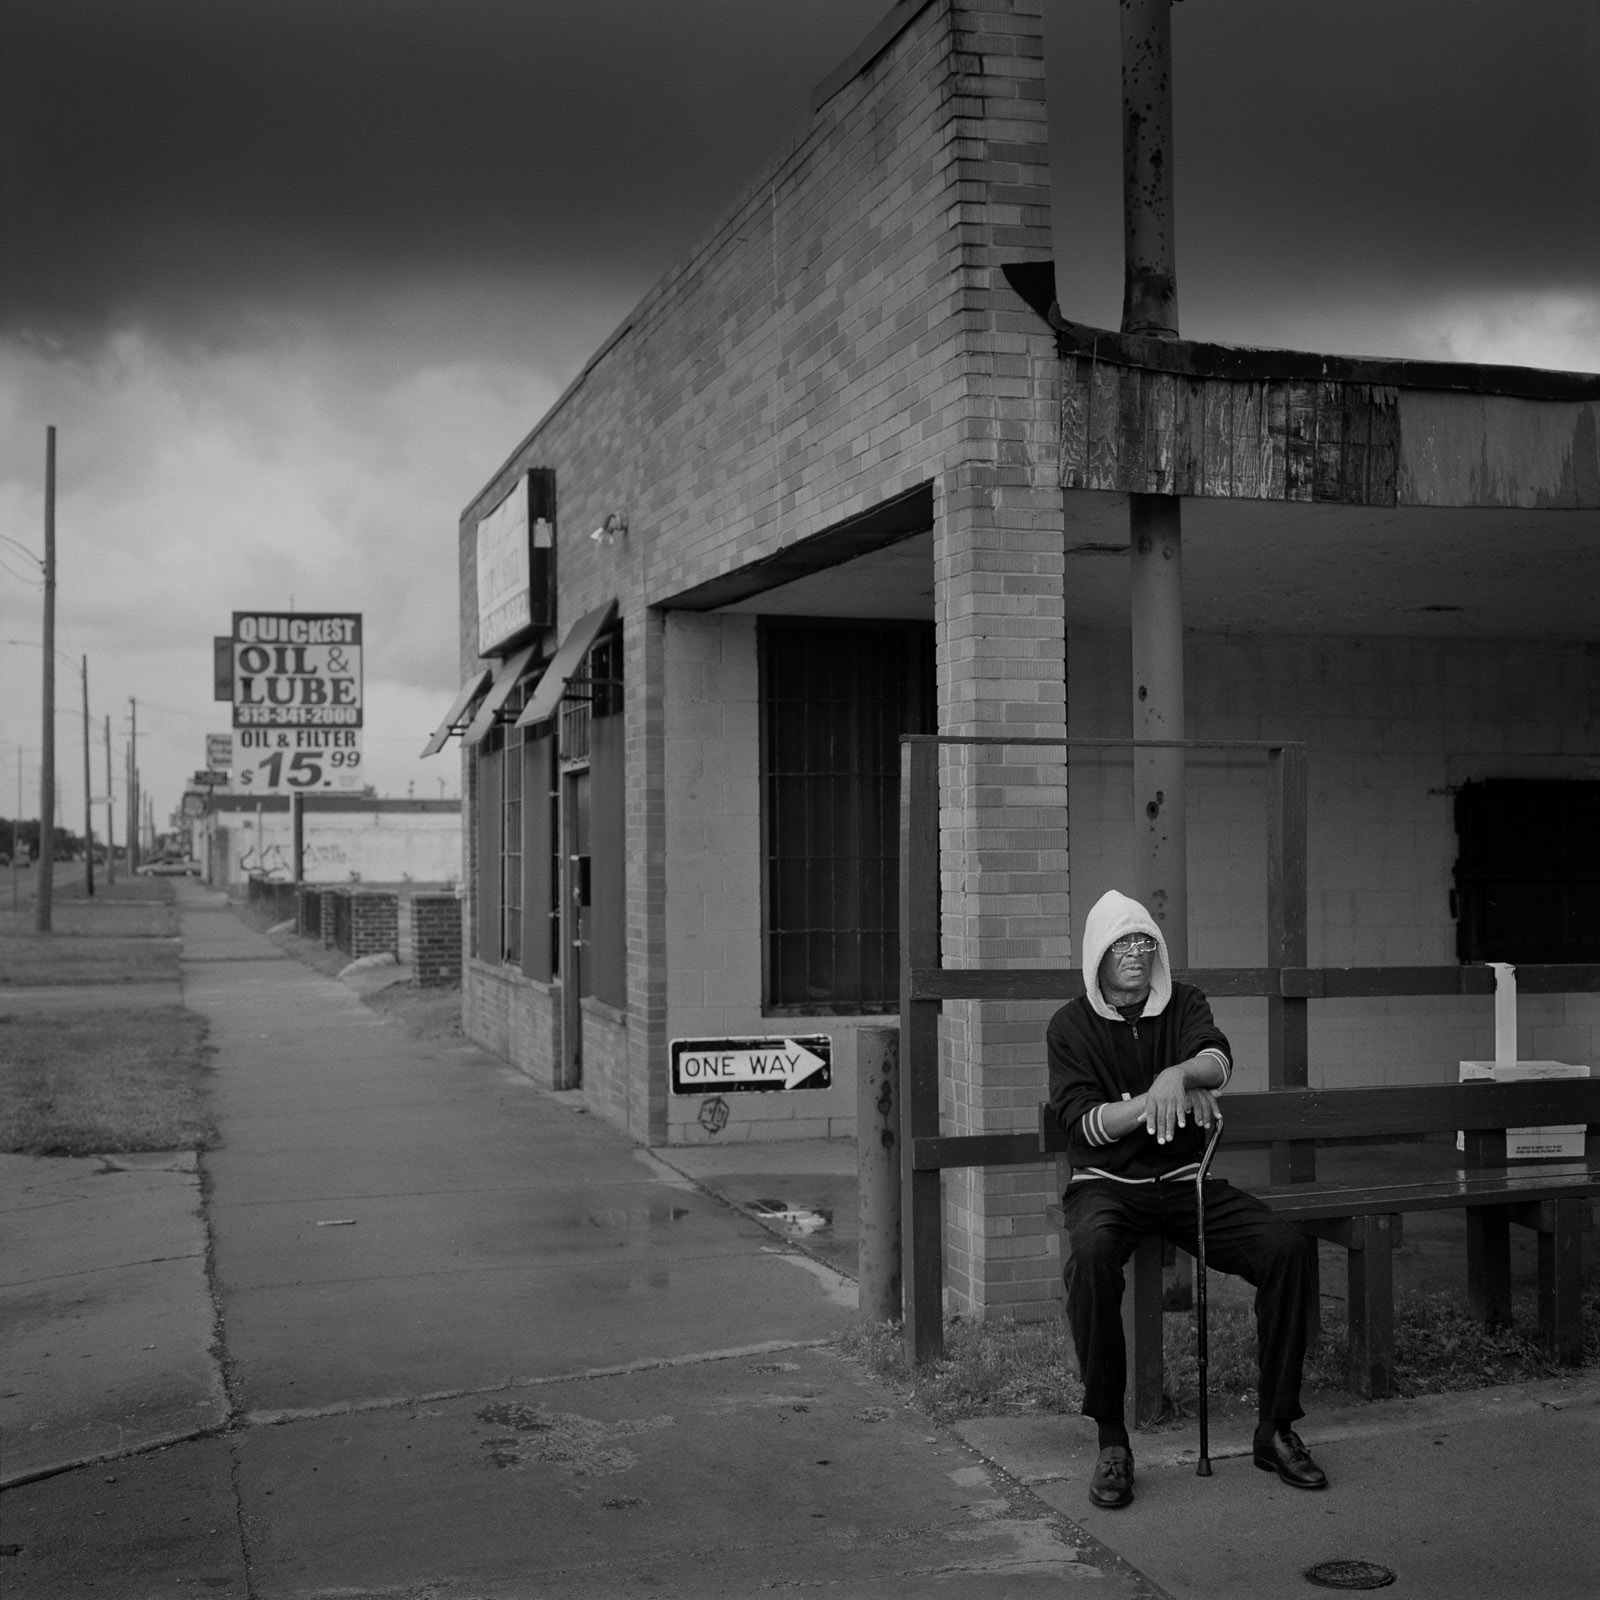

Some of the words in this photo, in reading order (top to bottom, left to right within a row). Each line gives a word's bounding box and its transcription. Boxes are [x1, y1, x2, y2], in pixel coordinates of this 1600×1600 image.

[239, 617, 355, 643] QUICKEST
[239, 647, 317, 674] OIL
[327, 647, 348, 674] &
[240, 678, 356, 705] LUBE
[239, 708, 356, 724] 313-341-2000
[242, 730, 270, 747] OIL
[278, 733, 290, 747] &
[297, 730, 356, 747] FILTER
[685, 1057, 735, 1077] ONE
[749, 1055, 800, 1074] WAY
